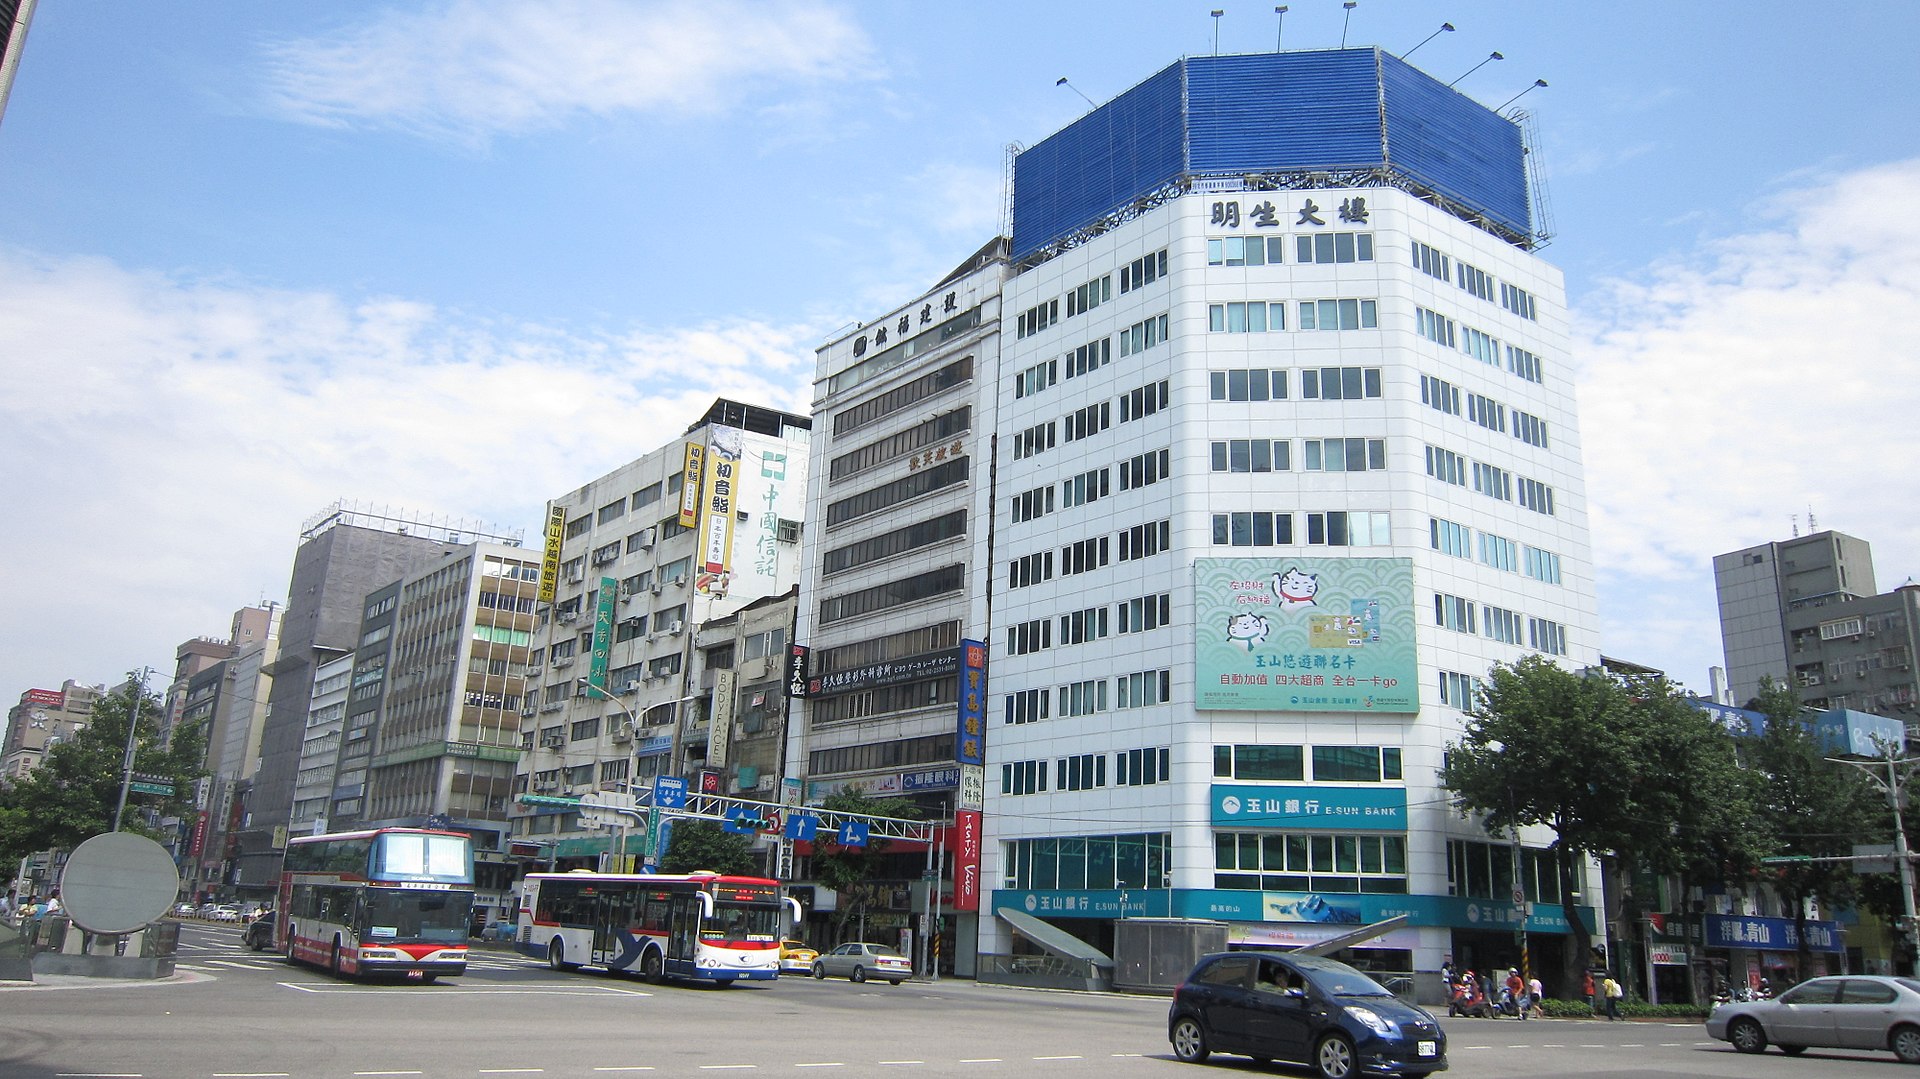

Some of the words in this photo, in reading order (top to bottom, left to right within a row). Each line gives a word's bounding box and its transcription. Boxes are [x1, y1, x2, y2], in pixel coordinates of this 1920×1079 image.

[1211, 196, 1369, 228] 明生大樓
[1256, 654, 1356, 669] 玉山悠遊聯名卡
[1220, 674, 1268, 685] 自動加值
[1275, 675, 1324, 686] 四大超商
[1332, 675, 1397, 688] 全台一卡go
[1247, 798, 1319, 814] 玉山銀行
[1325, 806, 1359, 815] E.SUN
[1365, 807, 1397, 816] BANK
[964, 814, 973, 857] TASTY
[1040, 896, 1089, 910] 玉山銀行
[1095, 902, 1119, 911] E.SUN
[1122, 902, 1144, 911] BANK
